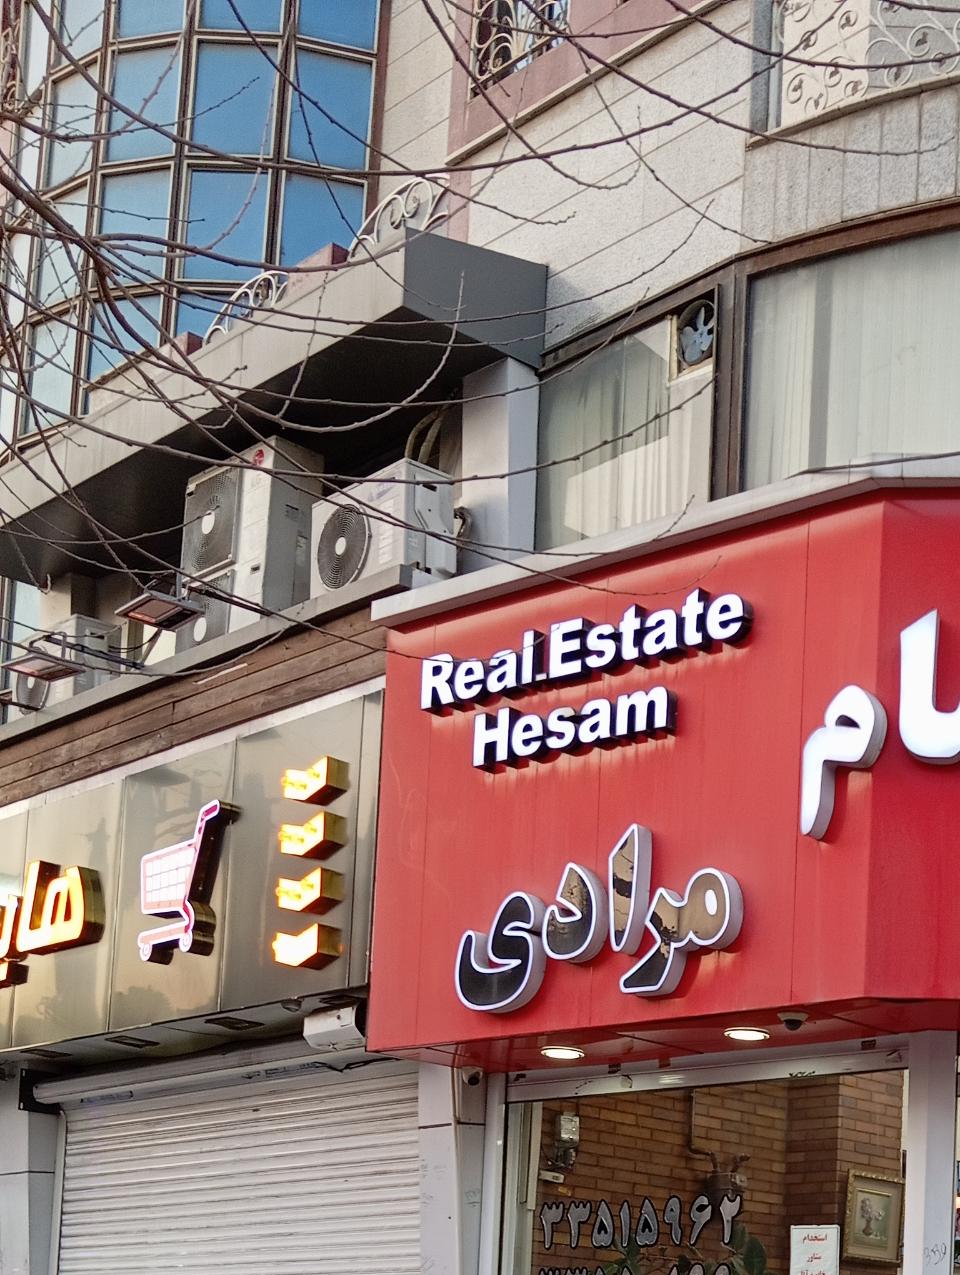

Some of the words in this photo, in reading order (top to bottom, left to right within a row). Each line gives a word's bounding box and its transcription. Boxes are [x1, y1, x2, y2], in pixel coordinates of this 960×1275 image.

[472, 685, 674, 771] Hesam
[455, 824, 743, 1013] مرادی
[540, 1194, 742, 1250] ۳۳۵۱۵۹۶۲
